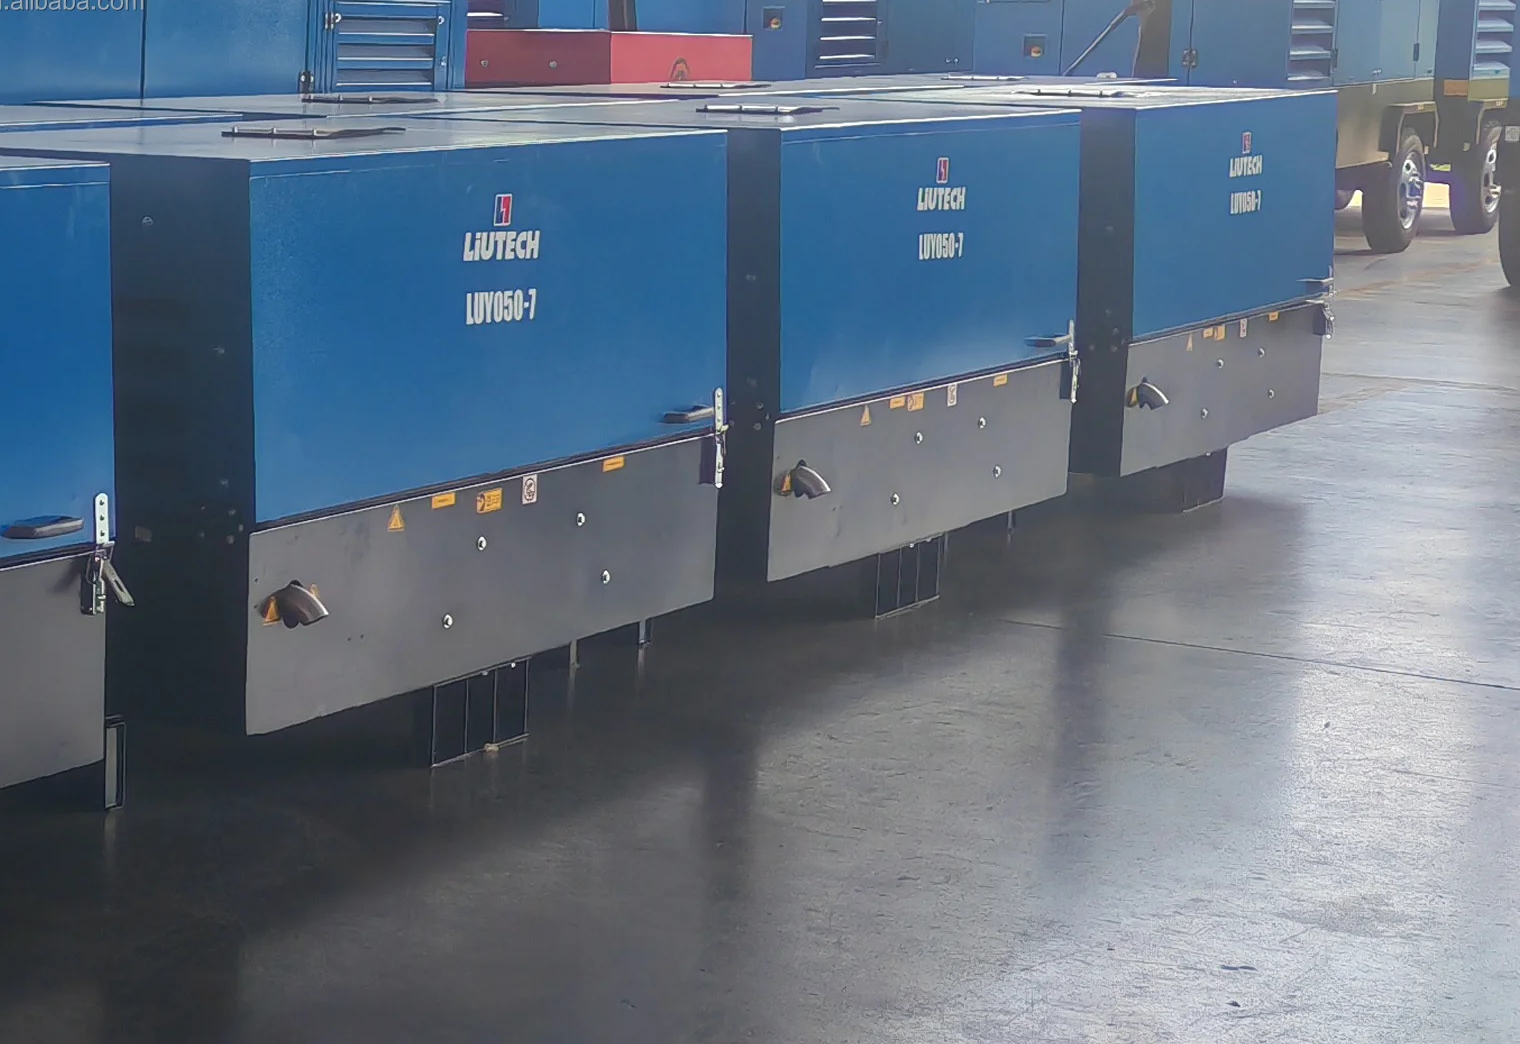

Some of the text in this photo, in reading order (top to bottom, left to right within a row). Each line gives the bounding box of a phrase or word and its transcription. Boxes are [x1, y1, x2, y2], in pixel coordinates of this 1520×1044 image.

[463, 230, 540, 261] LiUTECH
[918, 232, 964, 260] LUY050-7
[465, 288, 537, 325] LUY050-7
